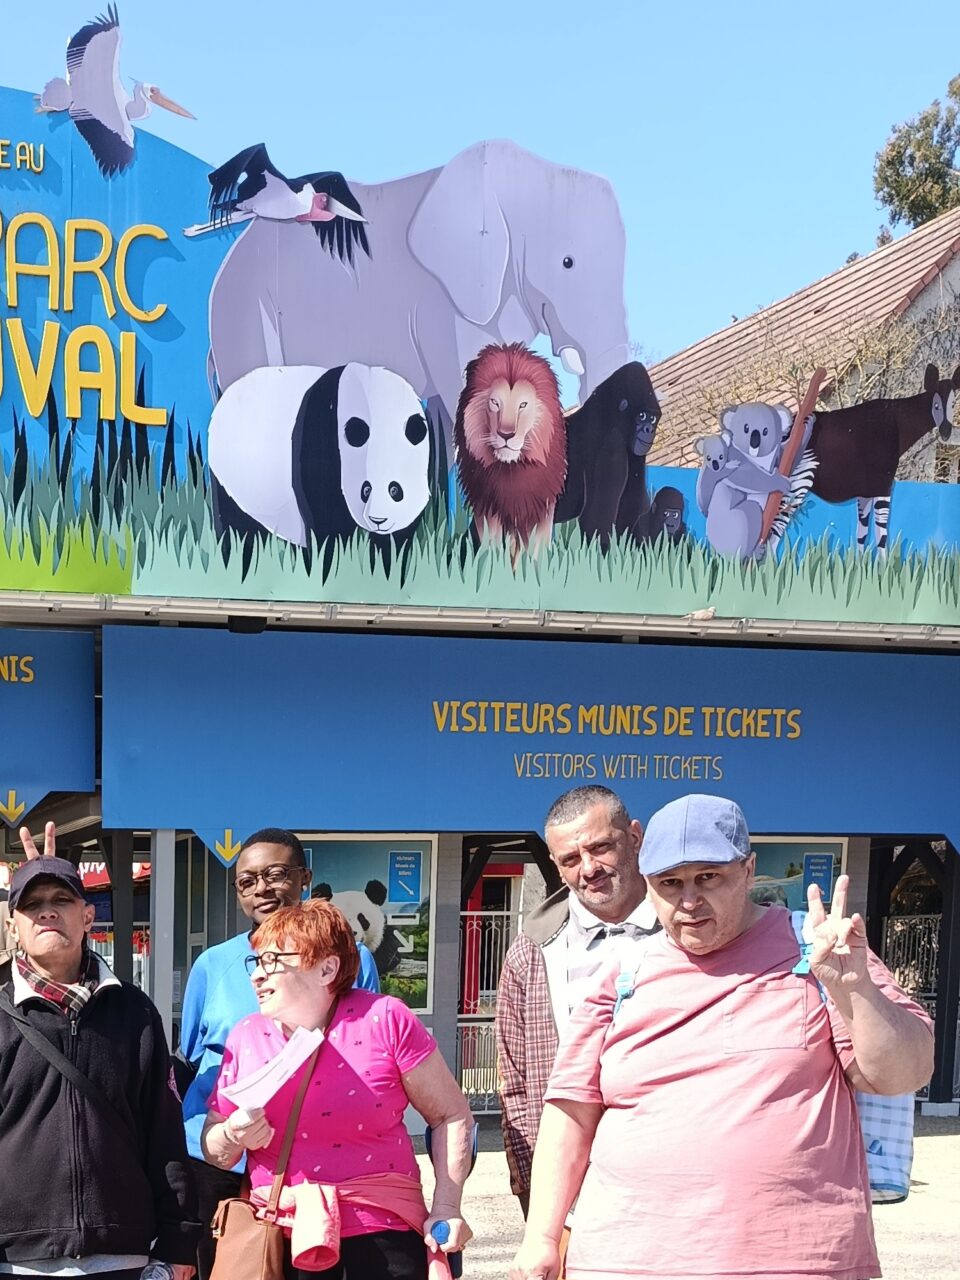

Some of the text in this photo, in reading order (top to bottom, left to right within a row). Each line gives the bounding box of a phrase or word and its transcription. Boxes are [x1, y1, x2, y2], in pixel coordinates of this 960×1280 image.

[16, 141, 44, 173] AU
[432, 701, 801, 739] VISITEURS MUNIS DE TICKETS
[513, 753, 723, 780] VISITORS WITH TICKETS
